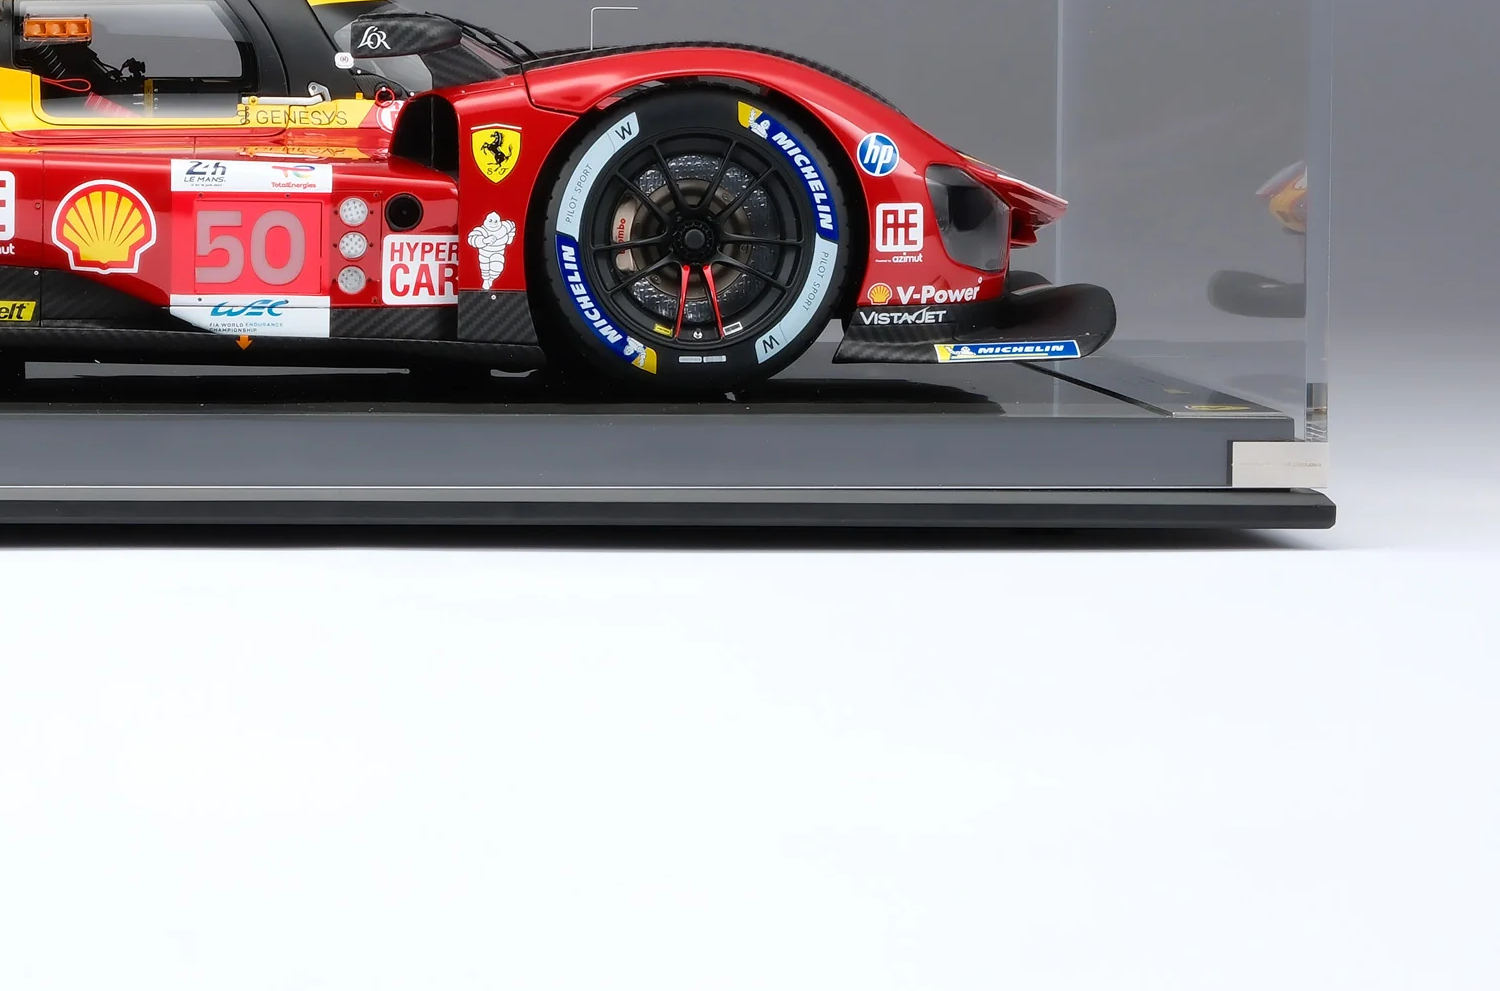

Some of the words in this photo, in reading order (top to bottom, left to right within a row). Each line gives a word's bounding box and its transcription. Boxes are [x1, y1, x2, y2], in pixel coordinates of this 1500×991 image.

[256, 110, 348, 125] GENESYS
[615, 122, 632, 141] W
[863, 133, 893, 175] hp
[185, 161, 226, 176] 24h
[771, 131, 833, 231] MICHELIN
[565, 195, 579, 224] PILOT
[574, 163, 593, 194] SPORT
[195, 210, 306, 285] 50
[390, 242, 459, 261] HYPER
[892, 252, 923, 262] azimut
[815, 251, 829, 279] PILOT
[390, 263, 459, 297] CAR
[561, 244, 623, 344] MICHELIN
[802, 281, 821, 311] SPORT
[896, 286, 979, 304] V-Power
[211, 300, 284, 316] WEC
[762, 334, 780, 354] W
[978, 345, 1064, 354] MICHELIN
